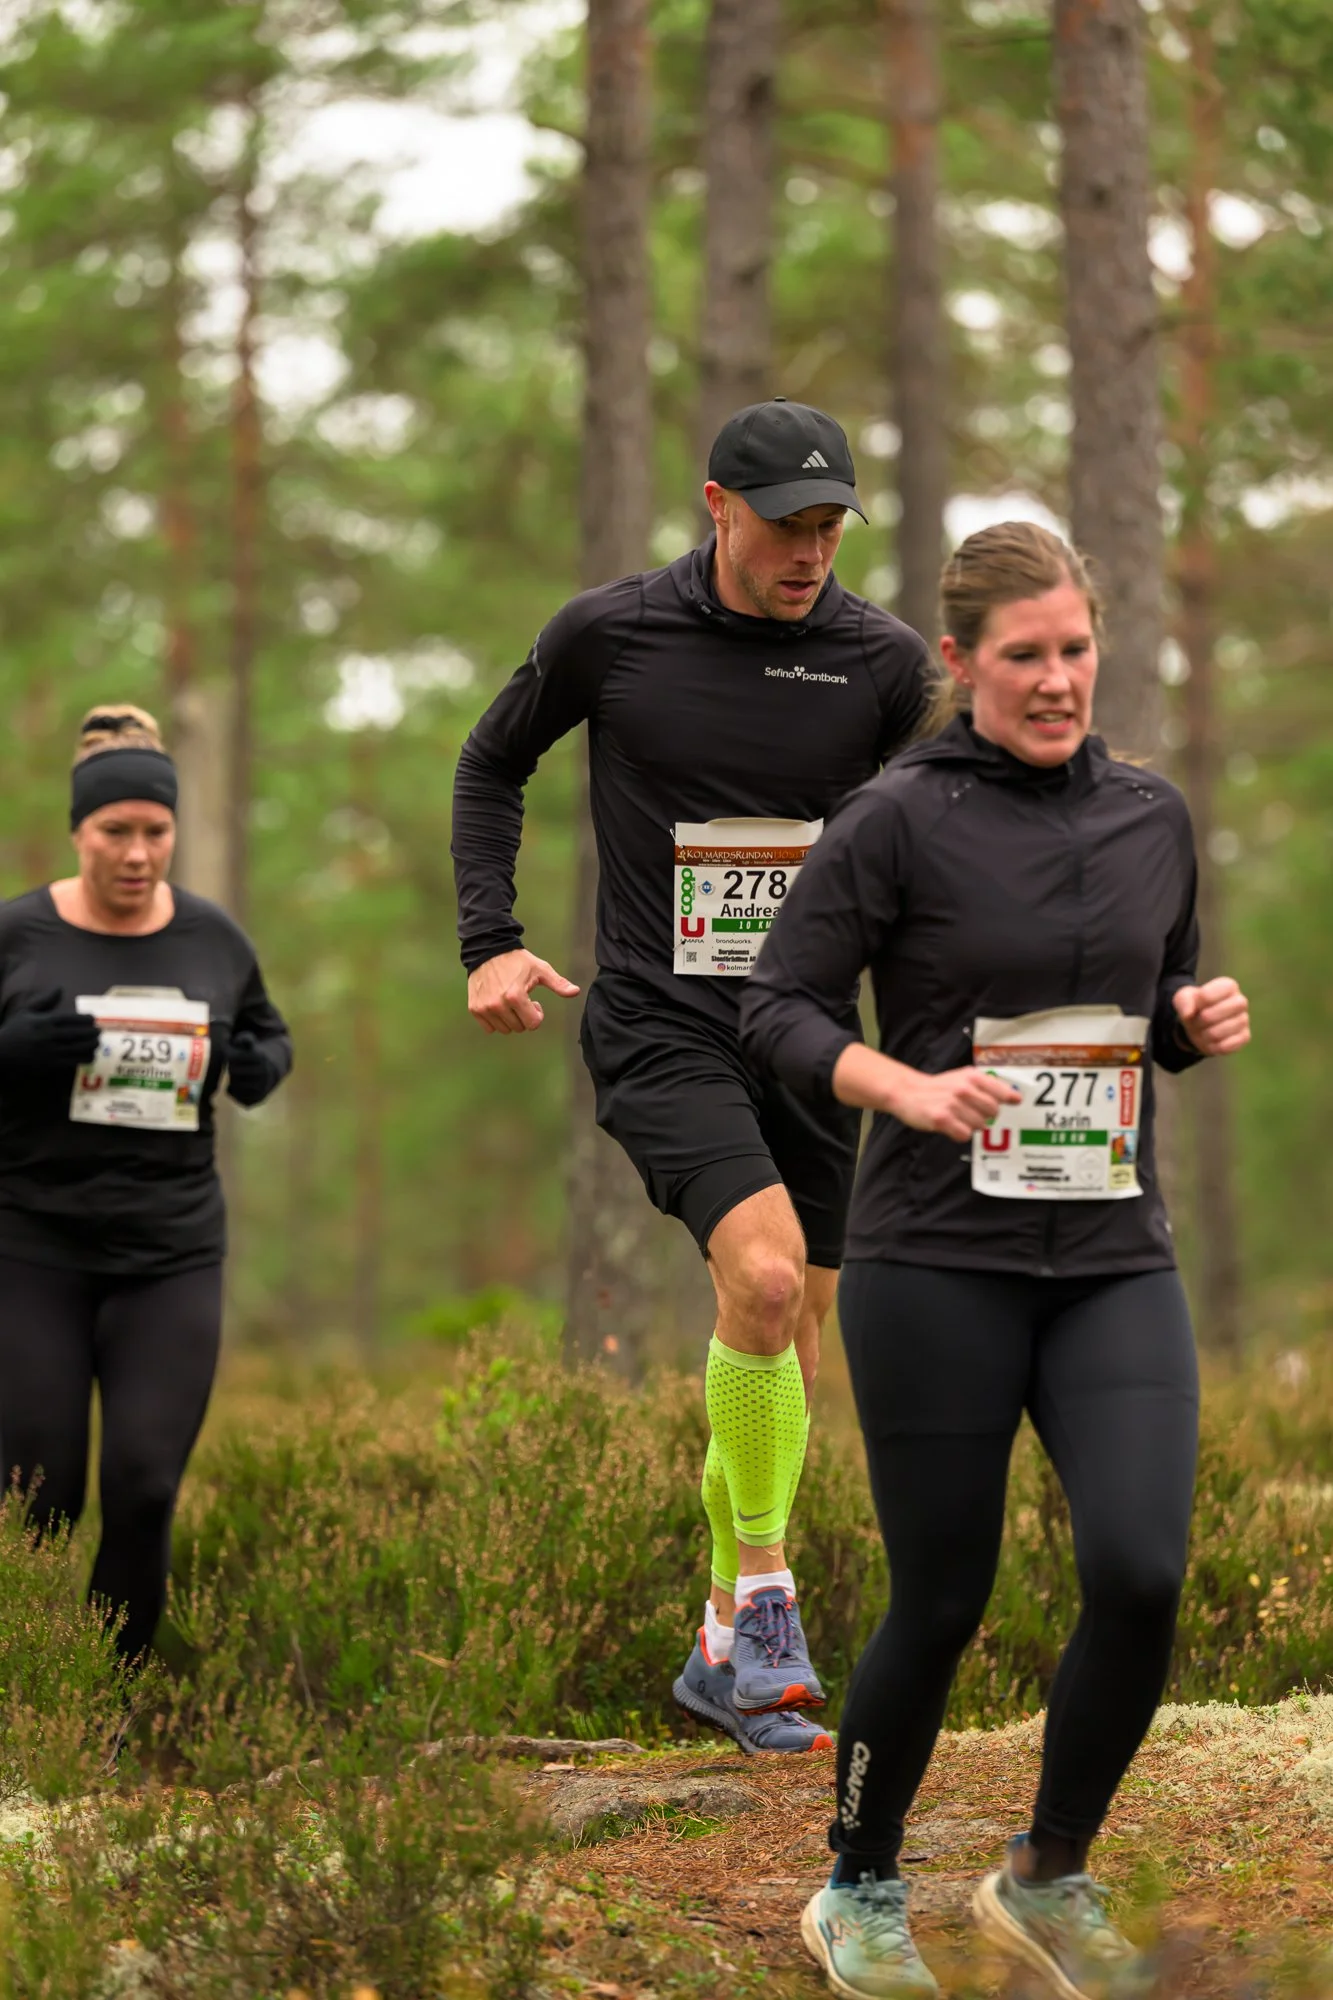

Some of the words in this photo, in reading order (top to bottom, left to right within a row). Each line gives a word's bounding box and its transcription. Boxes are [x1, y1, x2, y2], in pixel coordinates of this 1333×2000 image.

[764, 666, 796, 679] Sefina
[802, 672, 848, 684] pantbank
[681, 867, 696, 915] coop
[723, 869, 787, 900] 278
[680, 917, 705, 938] U
[738, 920, 752, 930] 10
[758, 920, 773, 930] KM
[120, 1038, 172, 1064] 259
[1034, 1071, 1099, 1107] 277
[1044, 1112, 1092, 1128] Karin
[982, 1128, 1012, 1152] U
[845, 1741, 872, 1817] CRAFT
